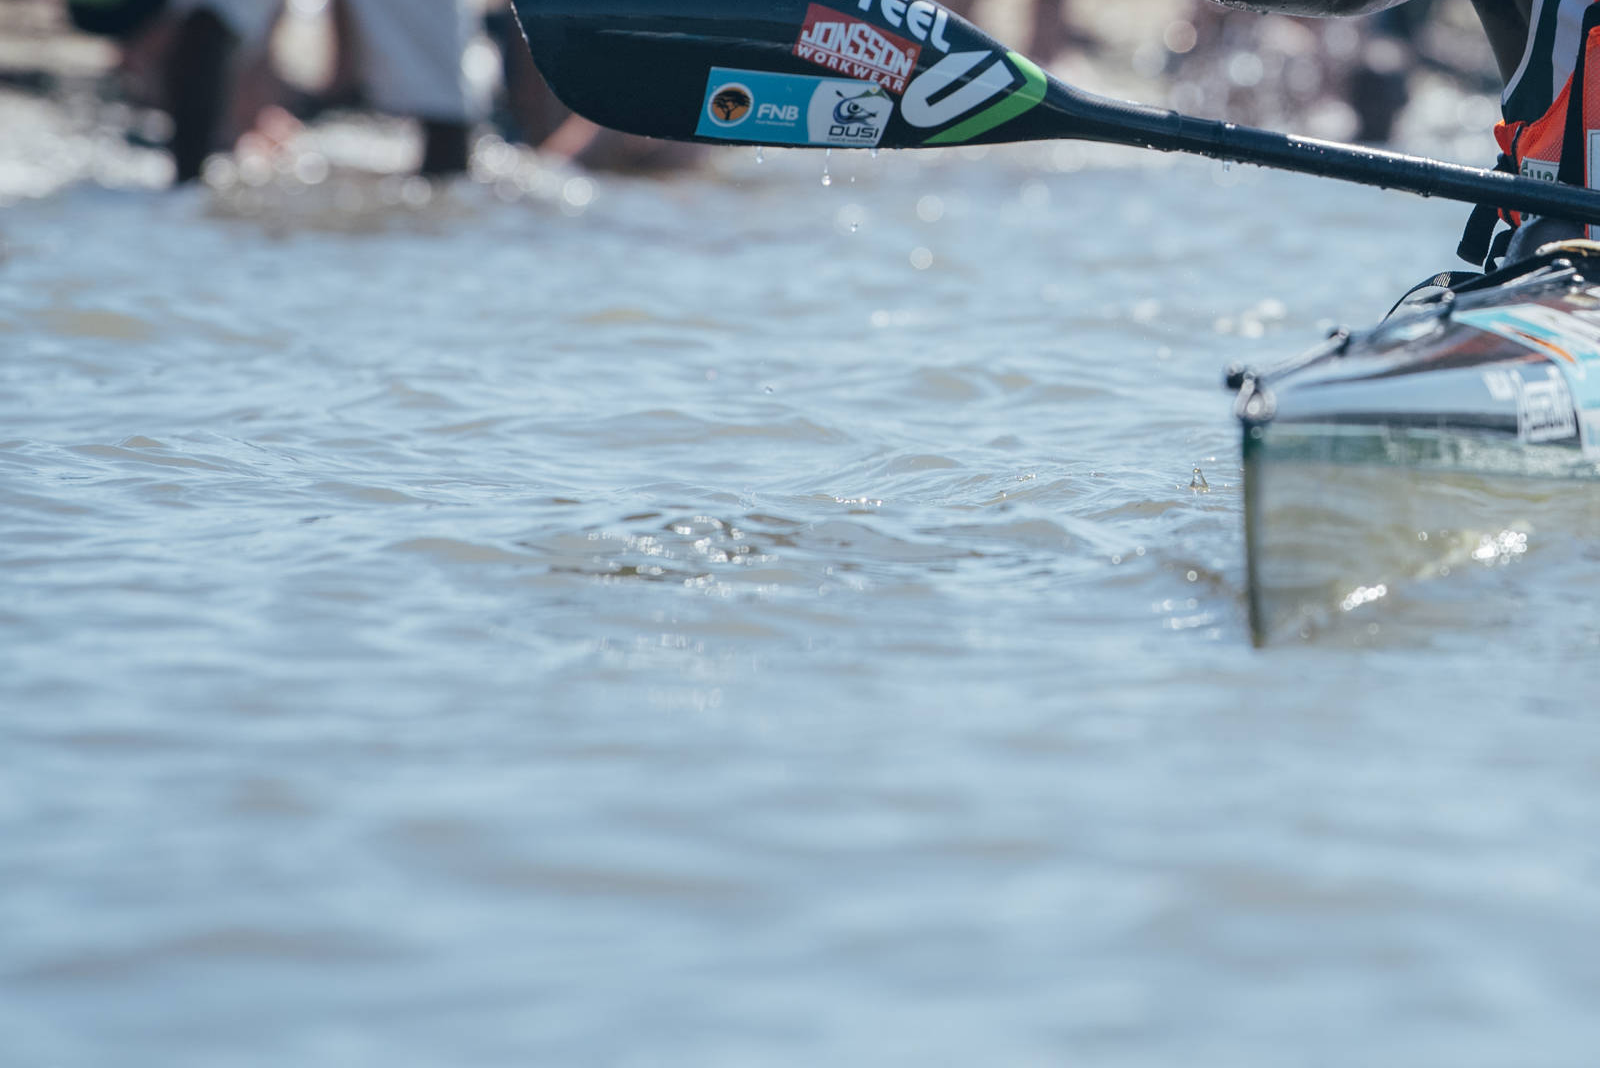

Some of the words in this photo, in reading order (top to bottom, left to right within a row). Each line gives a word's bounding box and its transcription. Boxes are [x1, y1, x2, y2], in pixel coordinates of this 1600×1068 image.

[800, 21, 913, 77] JONSSON
[797, 44, 905, 92] WORKWEAR
[756, 103, 799, 121] FNB
[828, 125, 879, 139] DUSI
